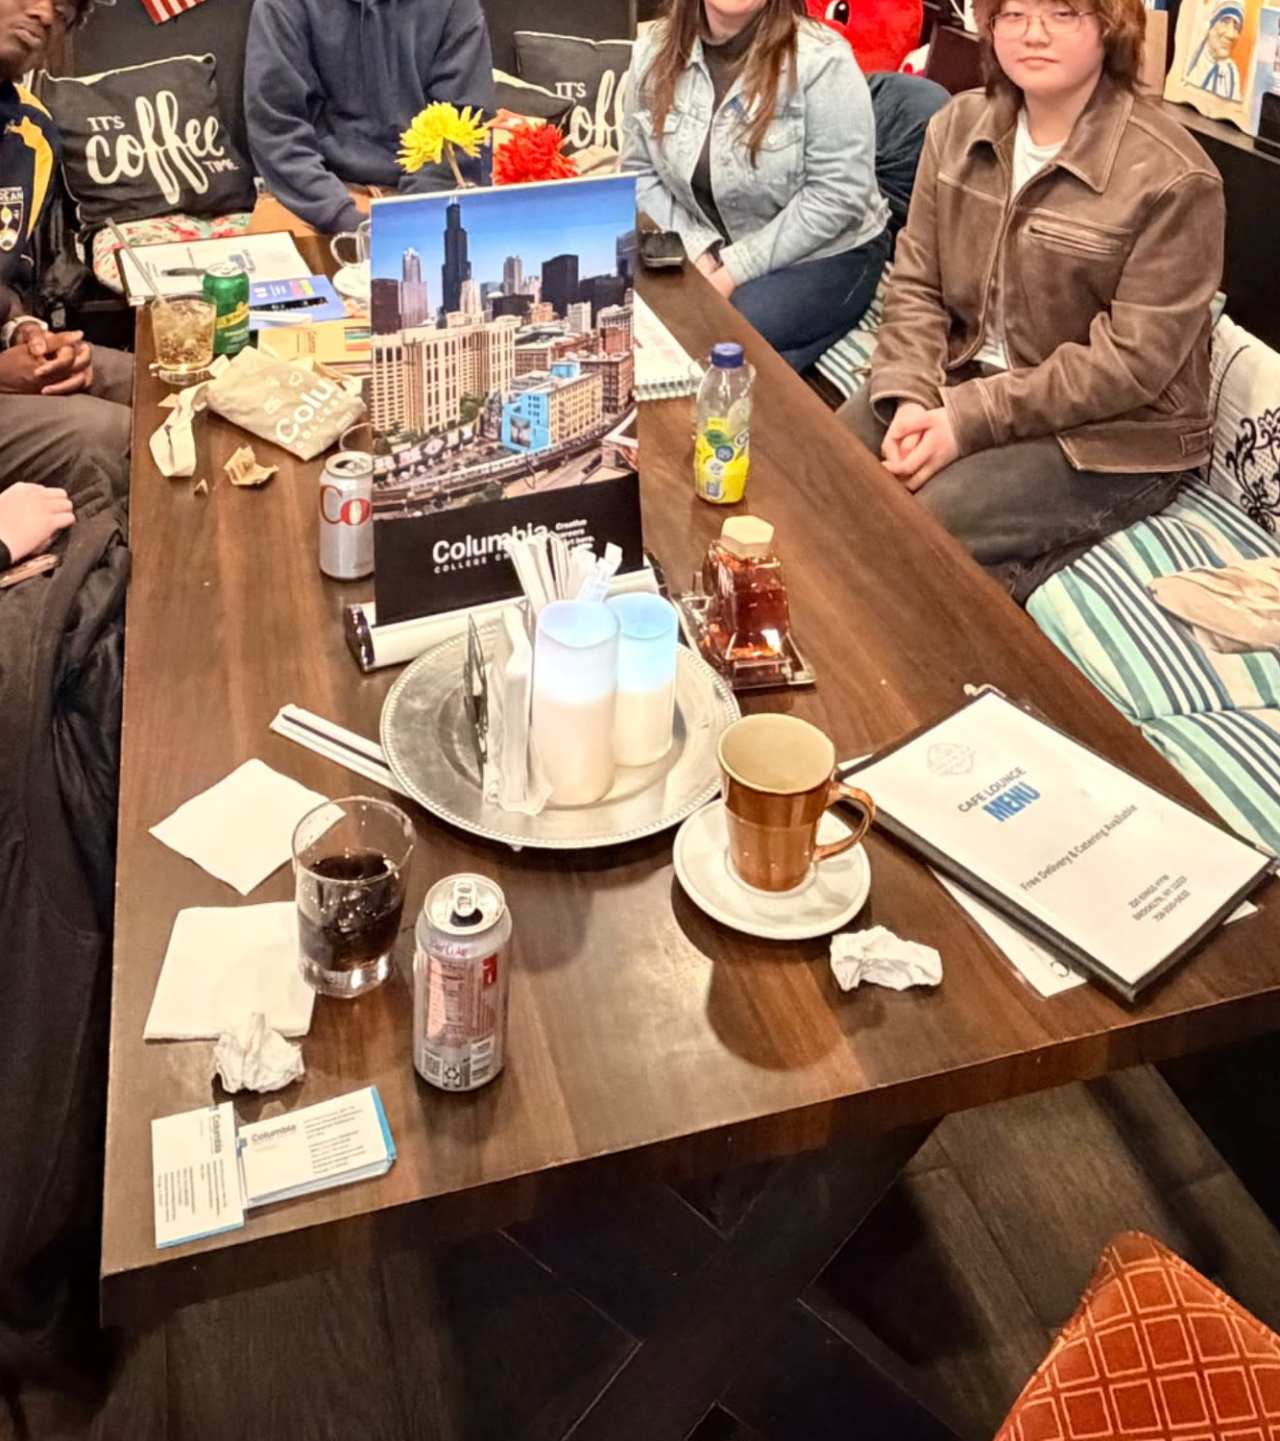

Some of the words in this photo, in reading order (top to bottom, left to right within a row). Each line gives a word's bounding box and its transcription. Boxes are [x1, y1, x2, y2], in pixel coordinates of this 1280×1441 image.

[85, 90, 225, 205] coffee
[957, 791, 988, 813] CAFE
[984, 766, 1027, 801] LOUNGE
[981, 781, 1041, 823] MENU
[1019, 876, 1042, 892] Free
[1037, 855, 1074, 880] Delivery
[1073, 829, 1110, 854] Catering
